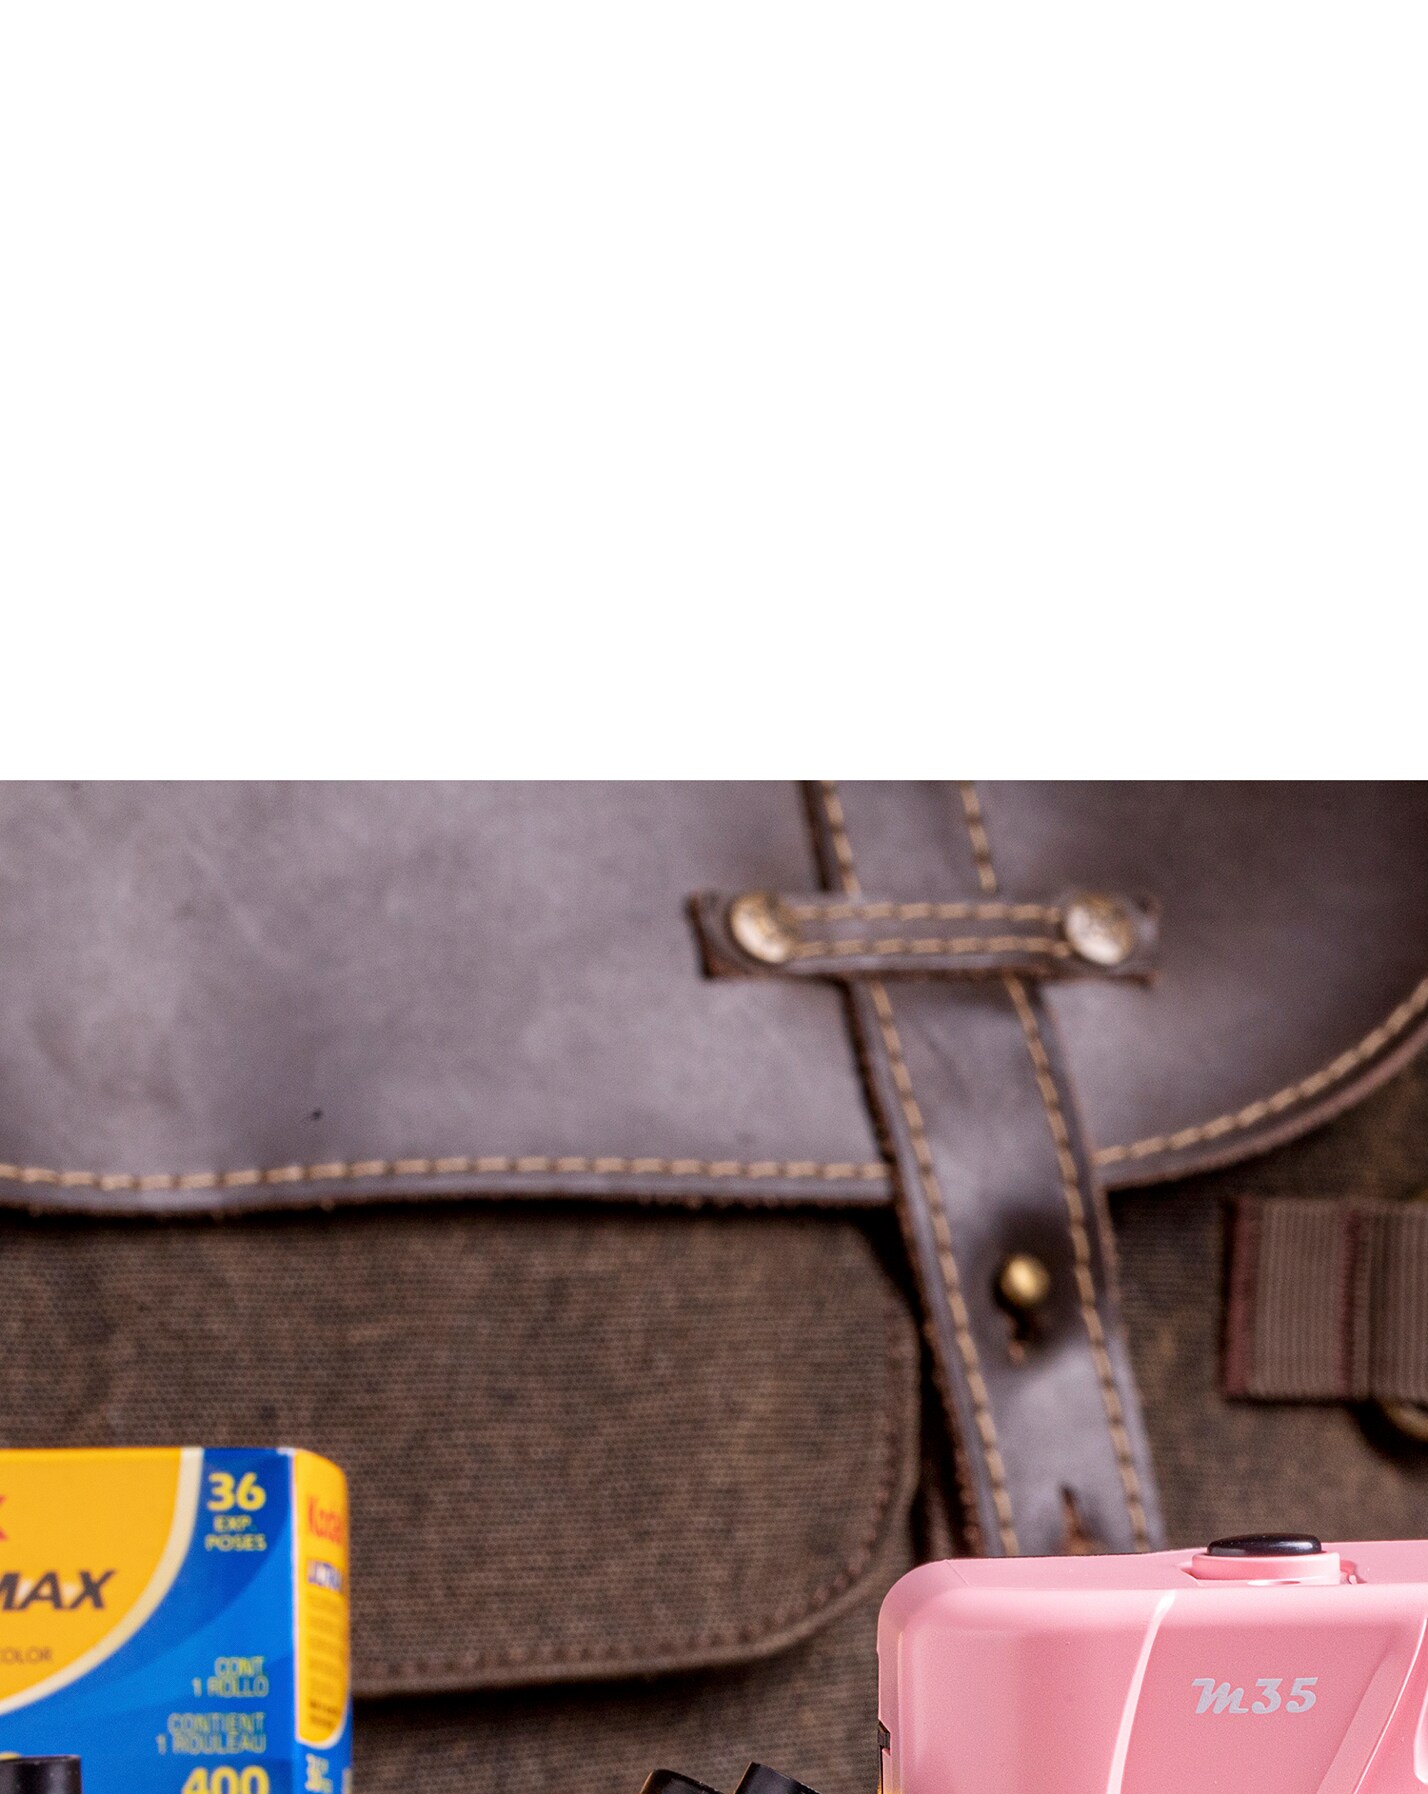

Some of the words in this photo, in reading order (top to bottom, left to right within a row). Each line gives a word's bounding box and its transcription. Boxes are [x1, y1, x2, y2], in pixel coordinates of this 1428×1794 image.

[207, 1472, 266, 1511] 36
[205, 1533, 267, 1551] POSES
[0, 1647, 52, 1664] OLOR
[192, 1677, 202, 1697] 1
[207, 1674, 269, 1698] ROLLO
[168, 1711, 265, 1735] CONTIENT
[156, 1733, 167, 1755] 1
[172, 1731, 266, 1755] ROULEAU
